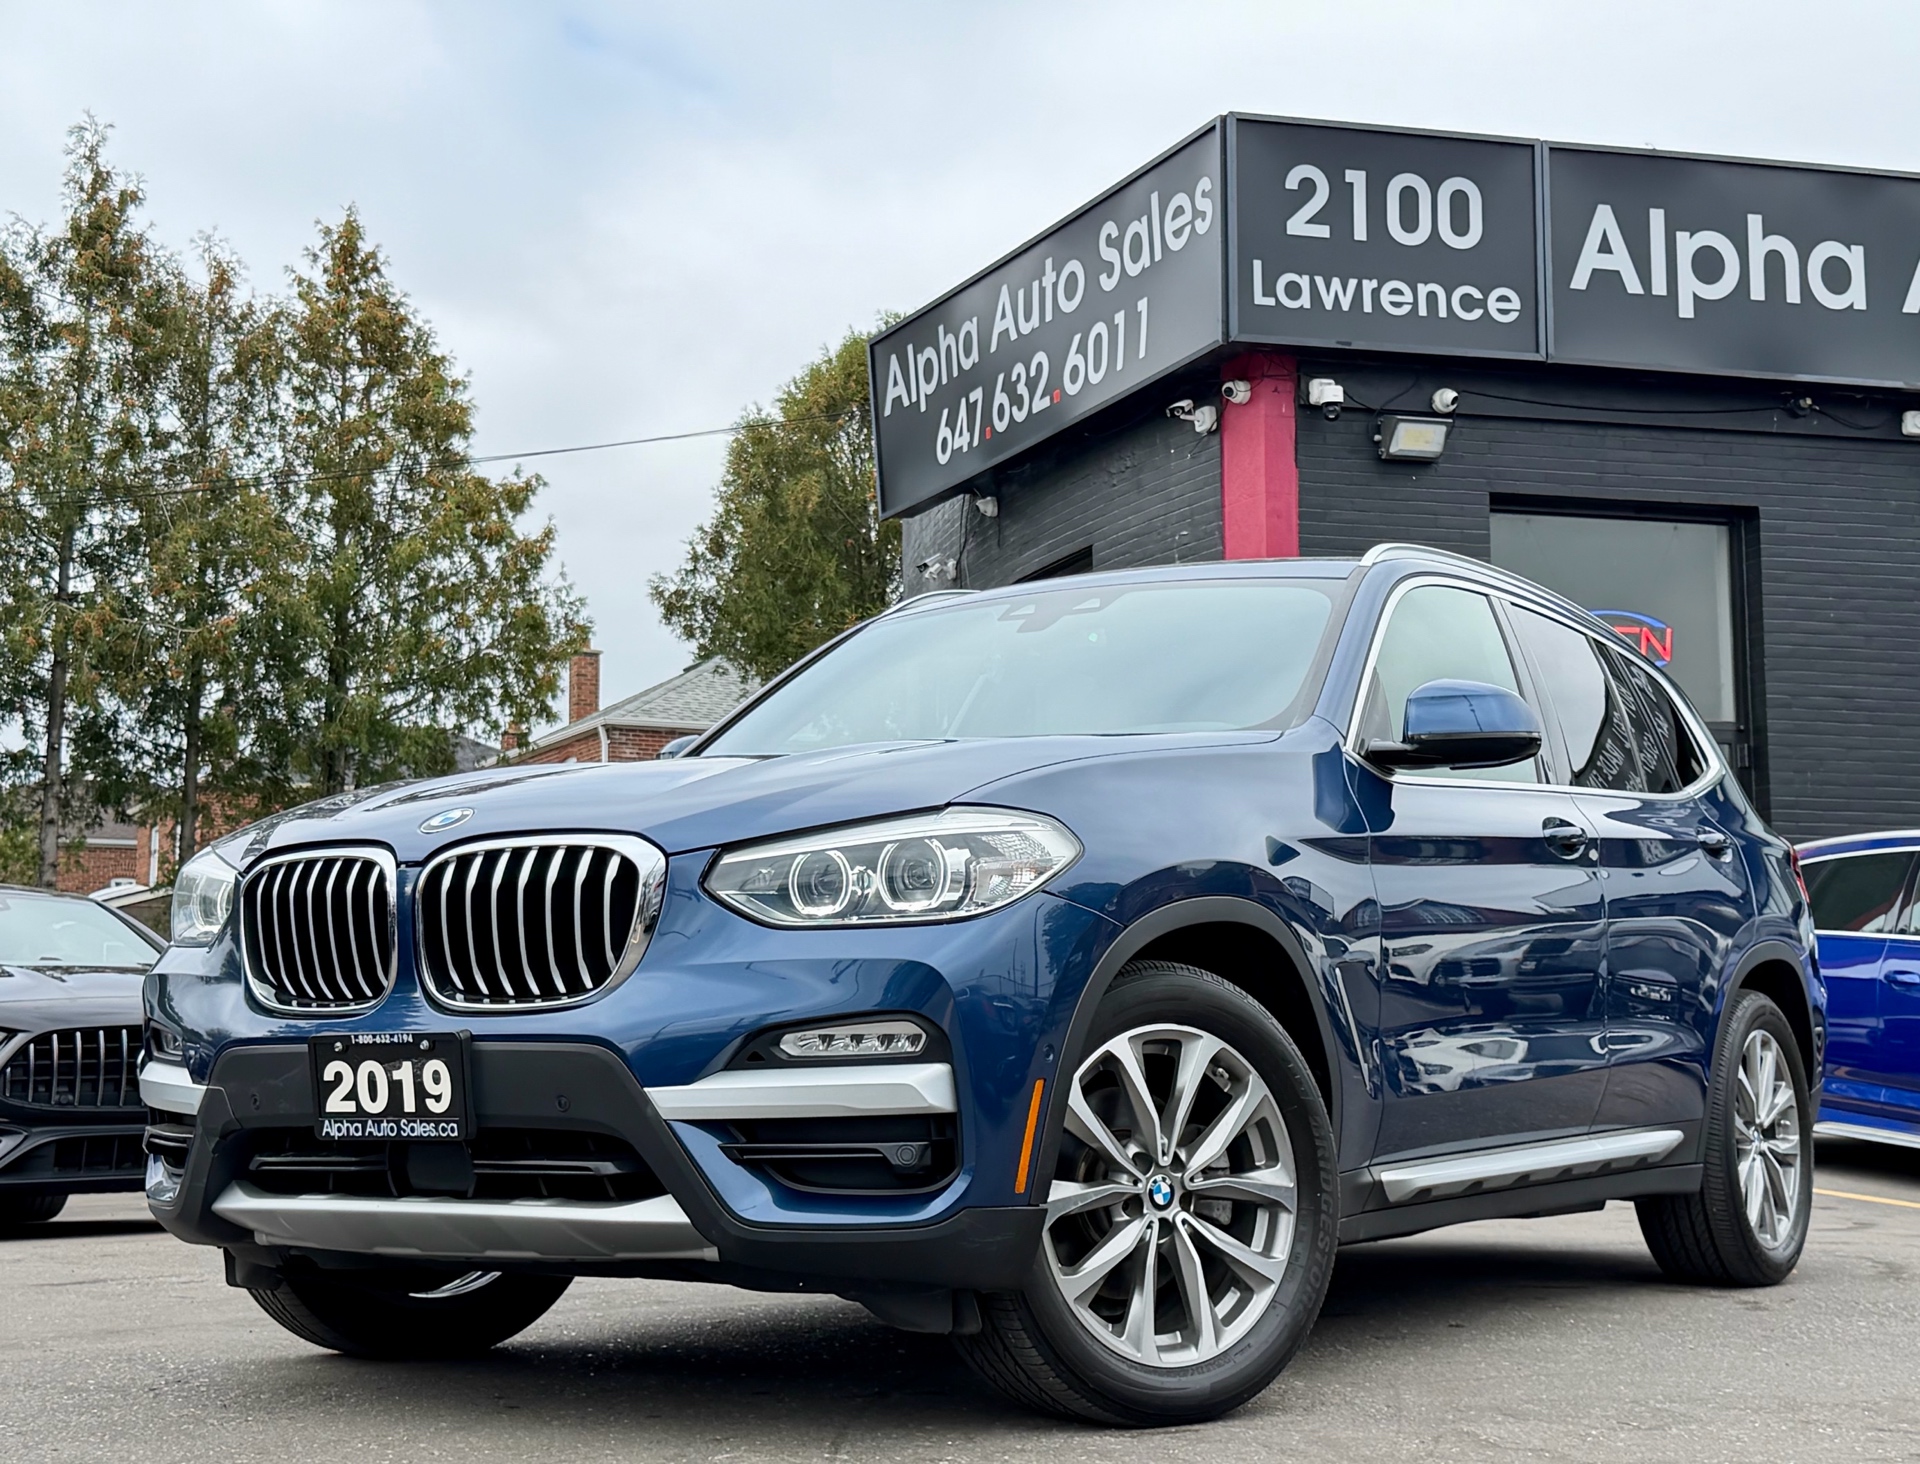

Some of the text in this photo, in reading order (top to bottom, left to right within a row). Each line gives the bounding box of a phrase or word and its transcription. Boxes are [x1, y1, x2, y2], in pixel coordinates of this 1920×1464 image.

[1284, 163, 1484, 250] 2100
[884, 175, 1214, 418] Alpha Auto Sales
[1252, 259, 1522, 324] Lawrence
[1569, 203, 1867, 319] Alpha
[935, 296, 1149, 465] 647.632.6011
[322, 1119, 458, 1140] Alpha Auto Sales.ca
[323, 1059, 452, 1114] 2019
